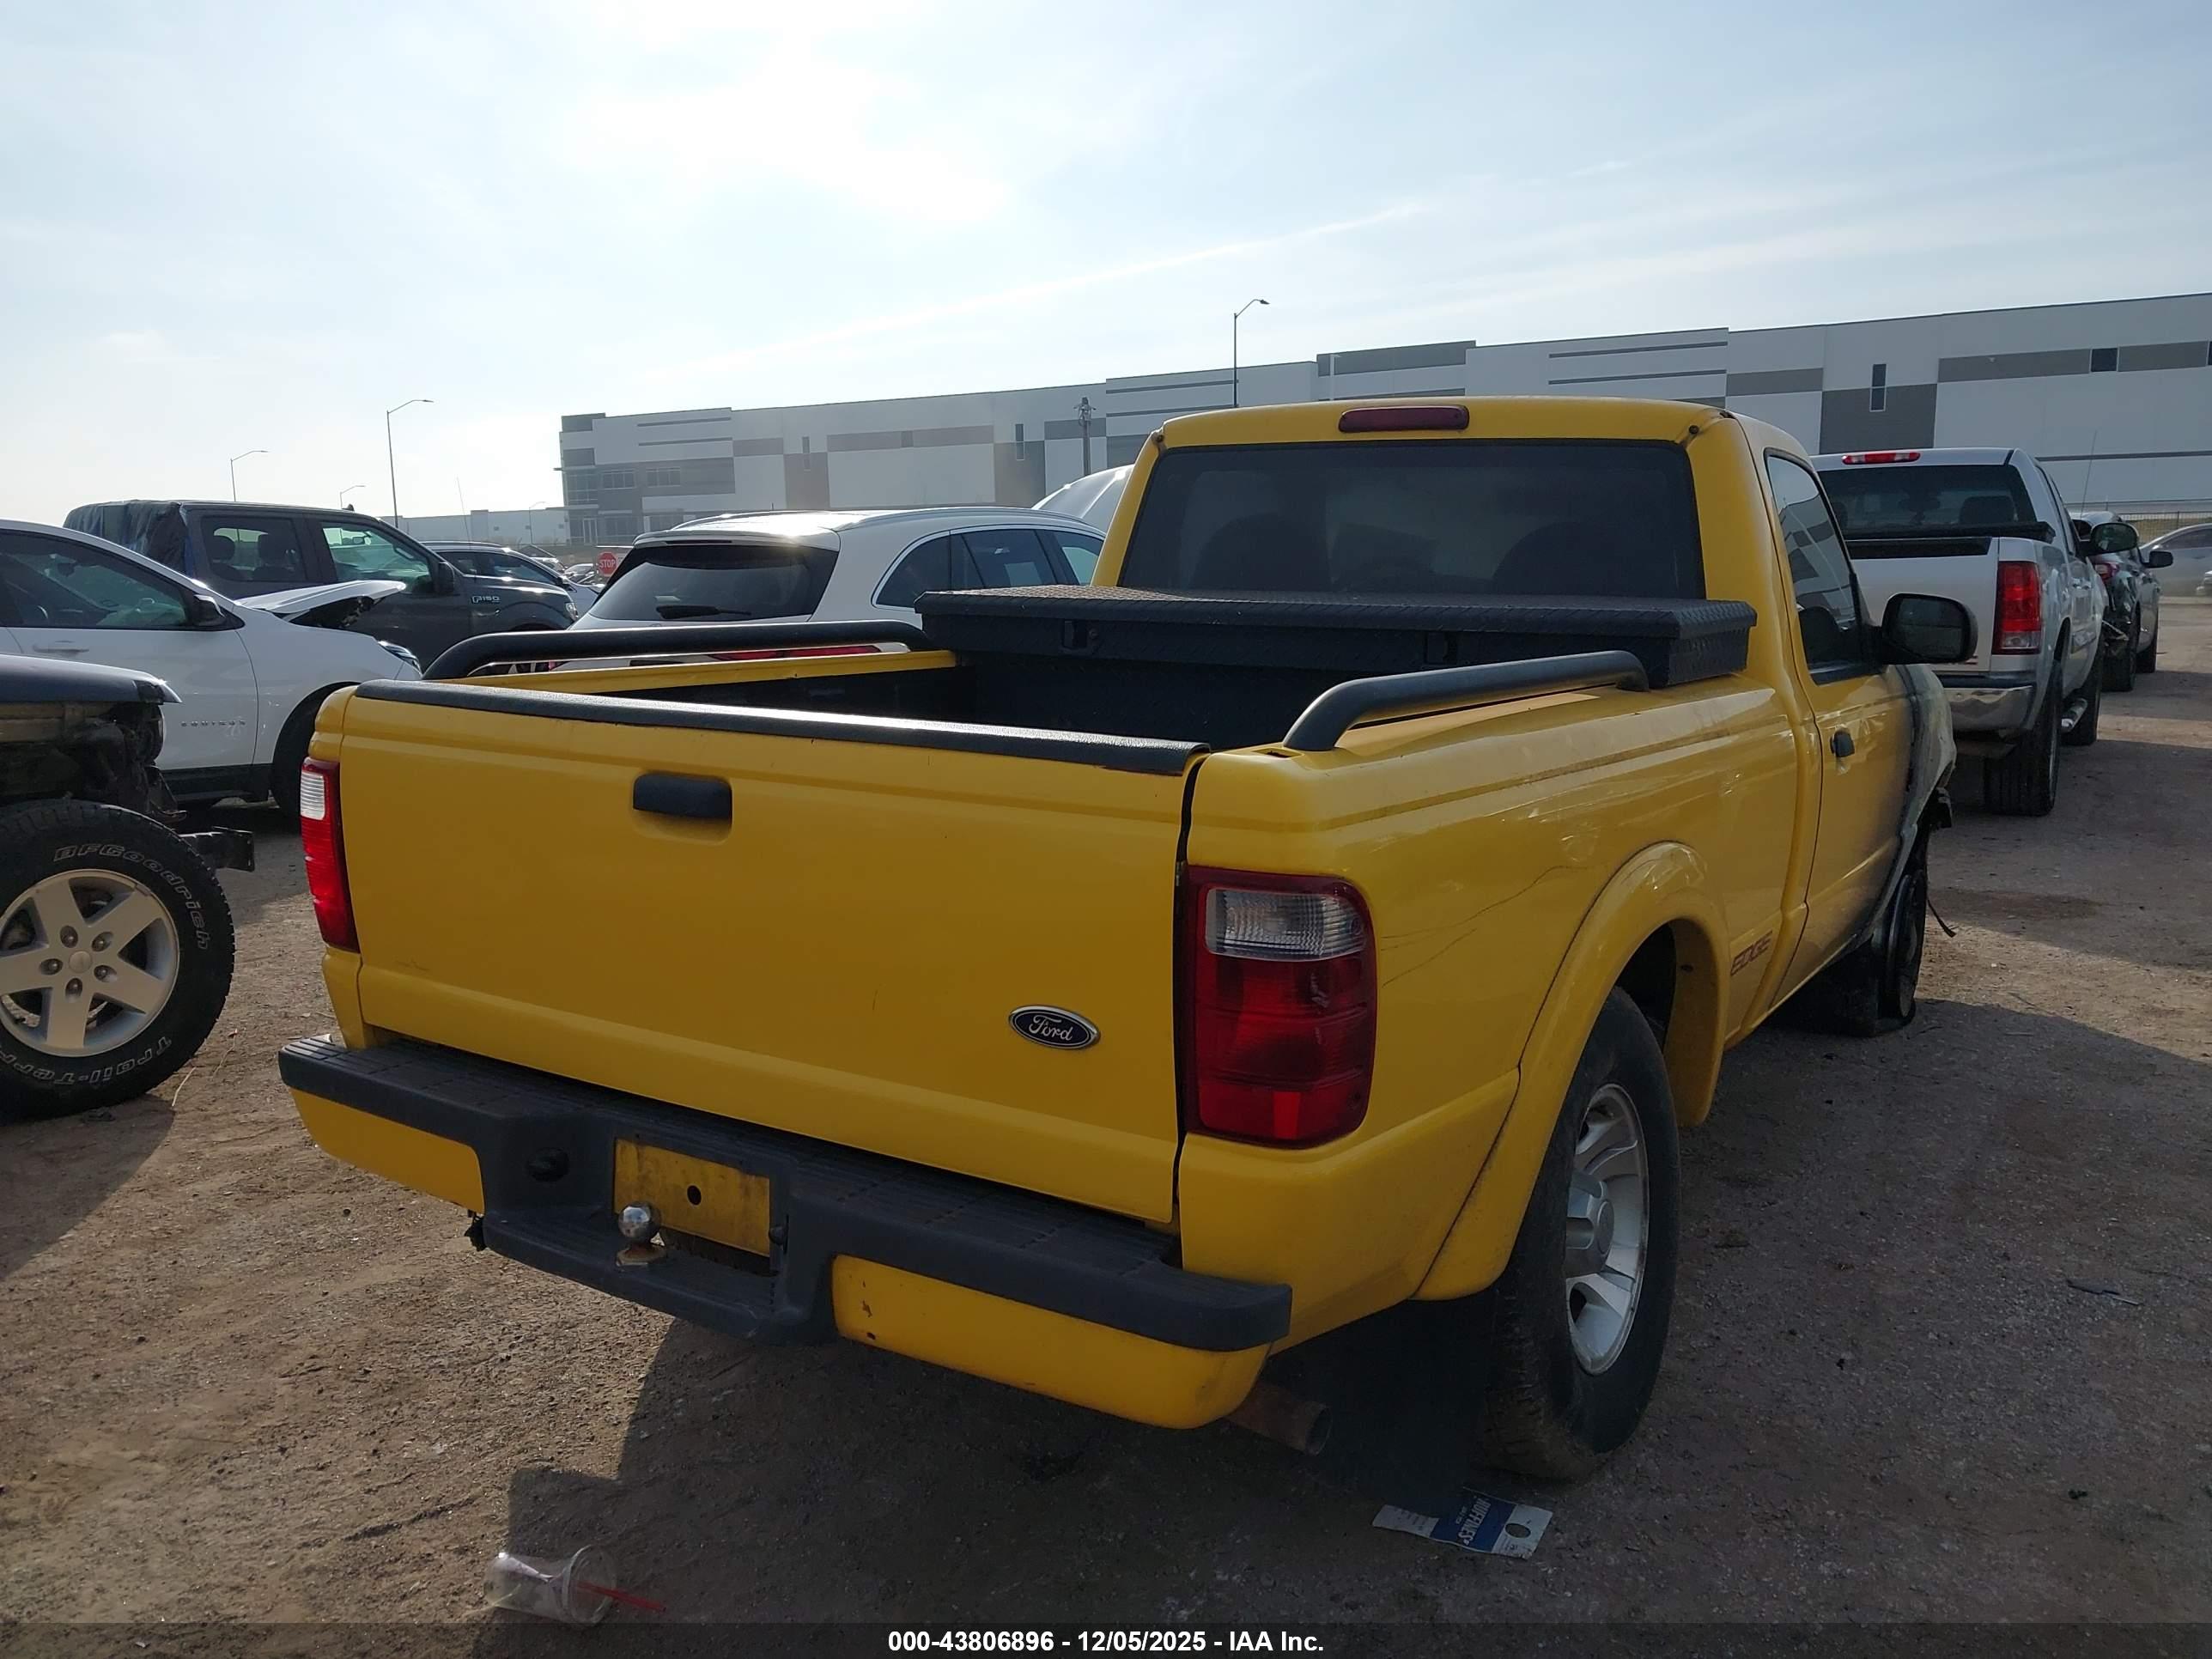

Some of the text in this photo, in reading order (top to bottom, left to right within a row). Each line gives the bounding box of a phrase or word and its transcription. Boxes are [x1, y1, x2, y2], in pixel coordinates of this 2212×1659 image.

[599, 559, 616, 568] STOP
[53, 843, 211, 950] BFGoodrich
[1028, 1013, 1074, 1042] Ford
